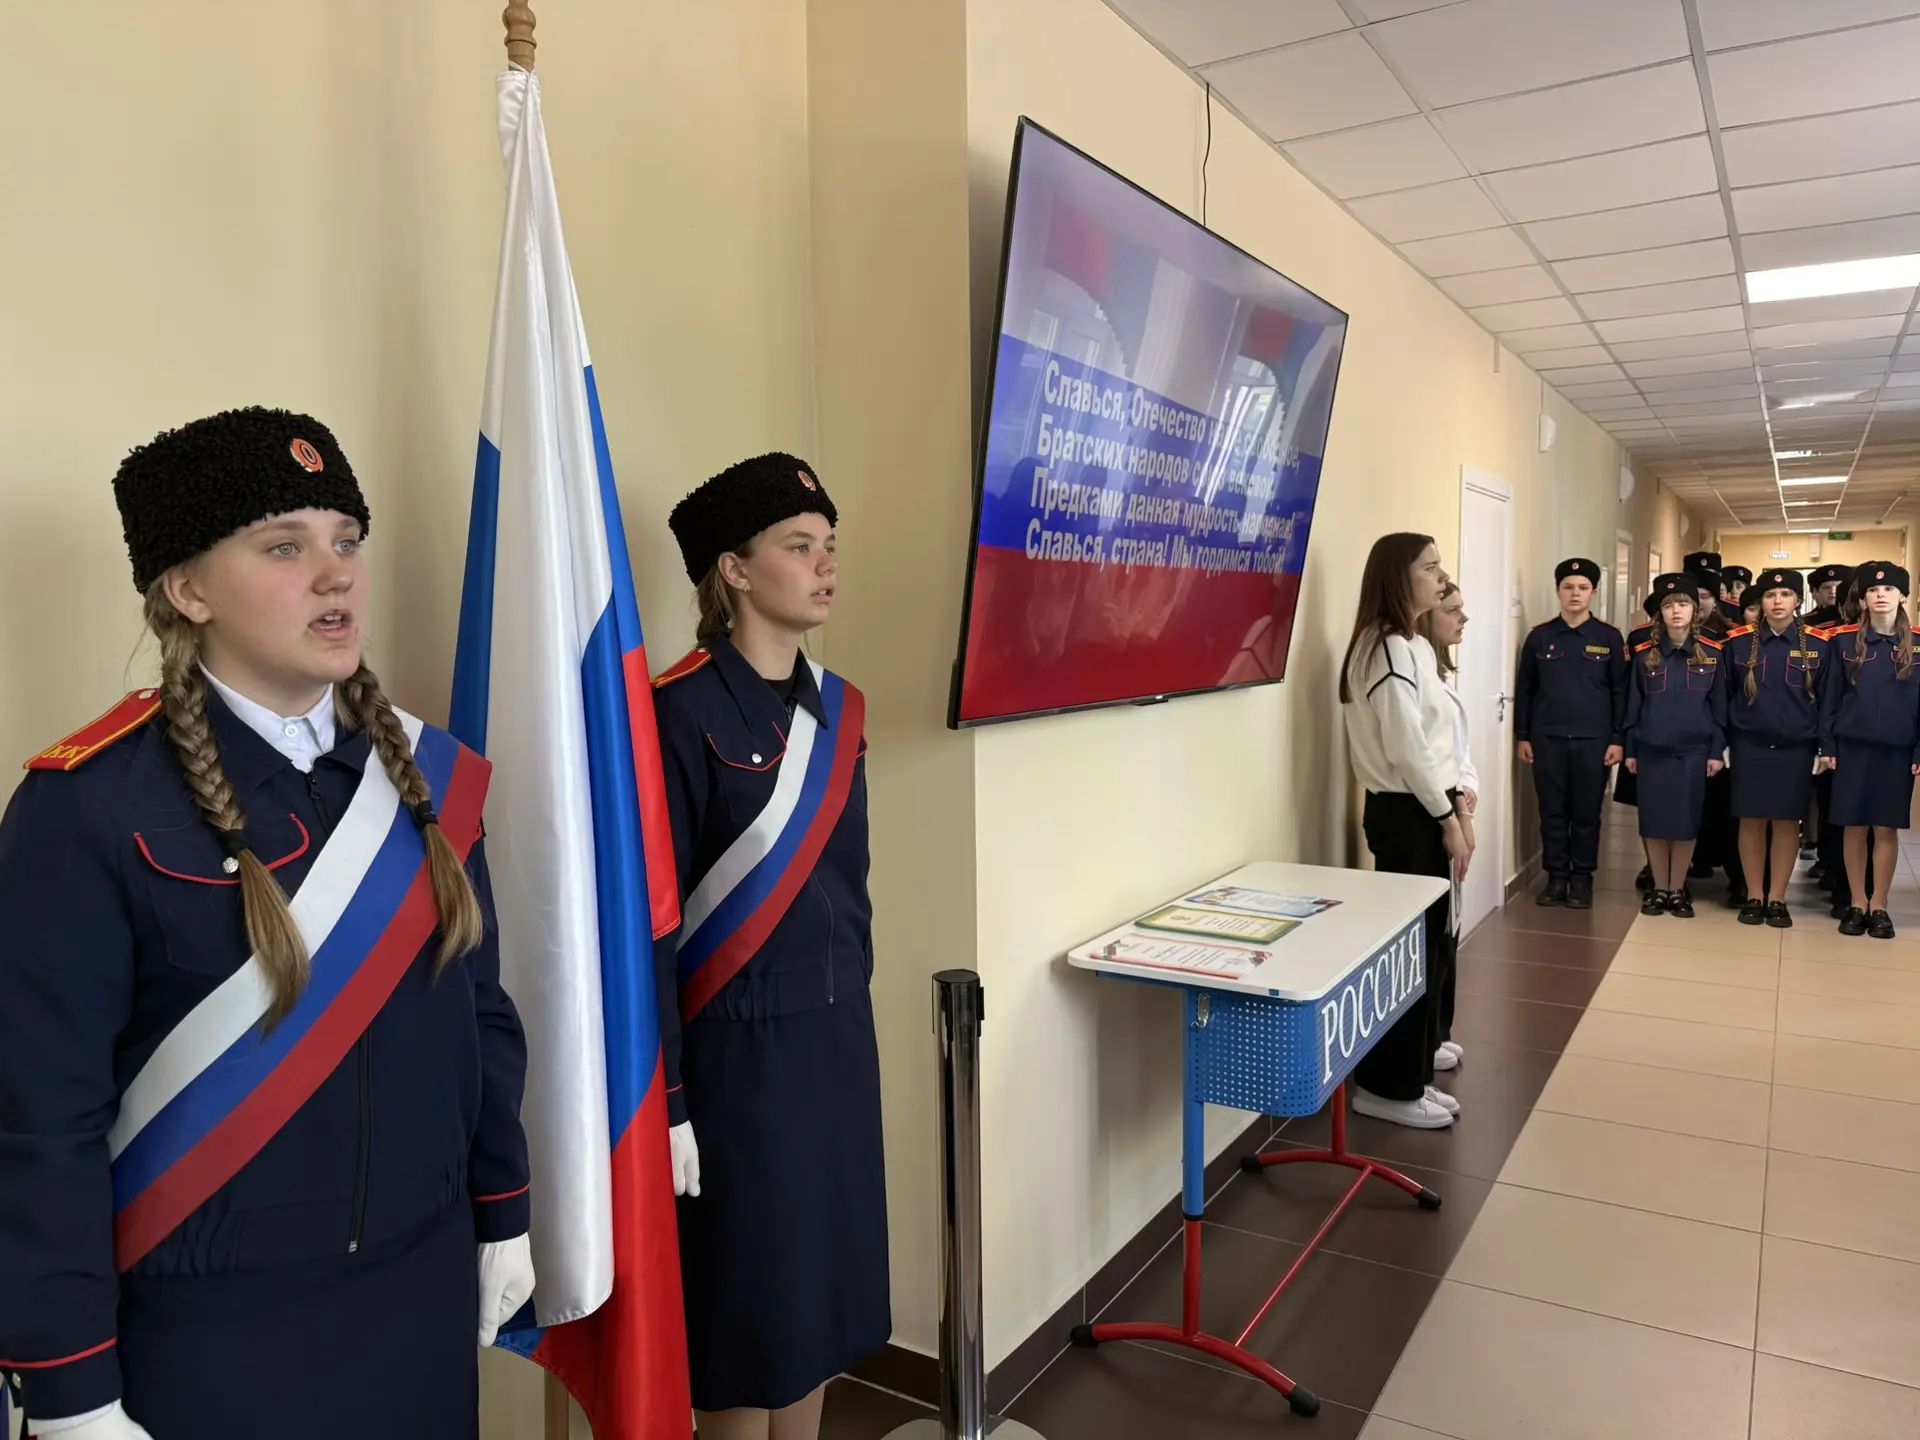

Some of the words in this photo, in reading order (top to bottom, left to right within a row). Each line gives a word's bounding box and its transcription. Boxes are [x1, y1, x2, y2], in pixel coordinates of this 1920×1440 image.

[1044, 359, 1125, 432] Славься,
[1131, 388, 1206, 443] Отечество
[1037, 413, 1124, 471] Братских
[1128, 444, 1188, 488] народов
[1030, 466, 1124, 520] Предками
[1125, 492, 1180, 528] данная
[1182, 502, 1240, 538] мудрость
[1240, 511, 1297, 542] народная!
[1025, 517, 1106, 573] Славься,
[1111, 534, 1170, 575] страна!
[1170, 534, 1192, 570] Мы
[1195, 547, 1251, 579] гордимся
[1252, 547, 1286, 574] тобой!
[1322, 922, 1423, 1085] РОССИЯ
